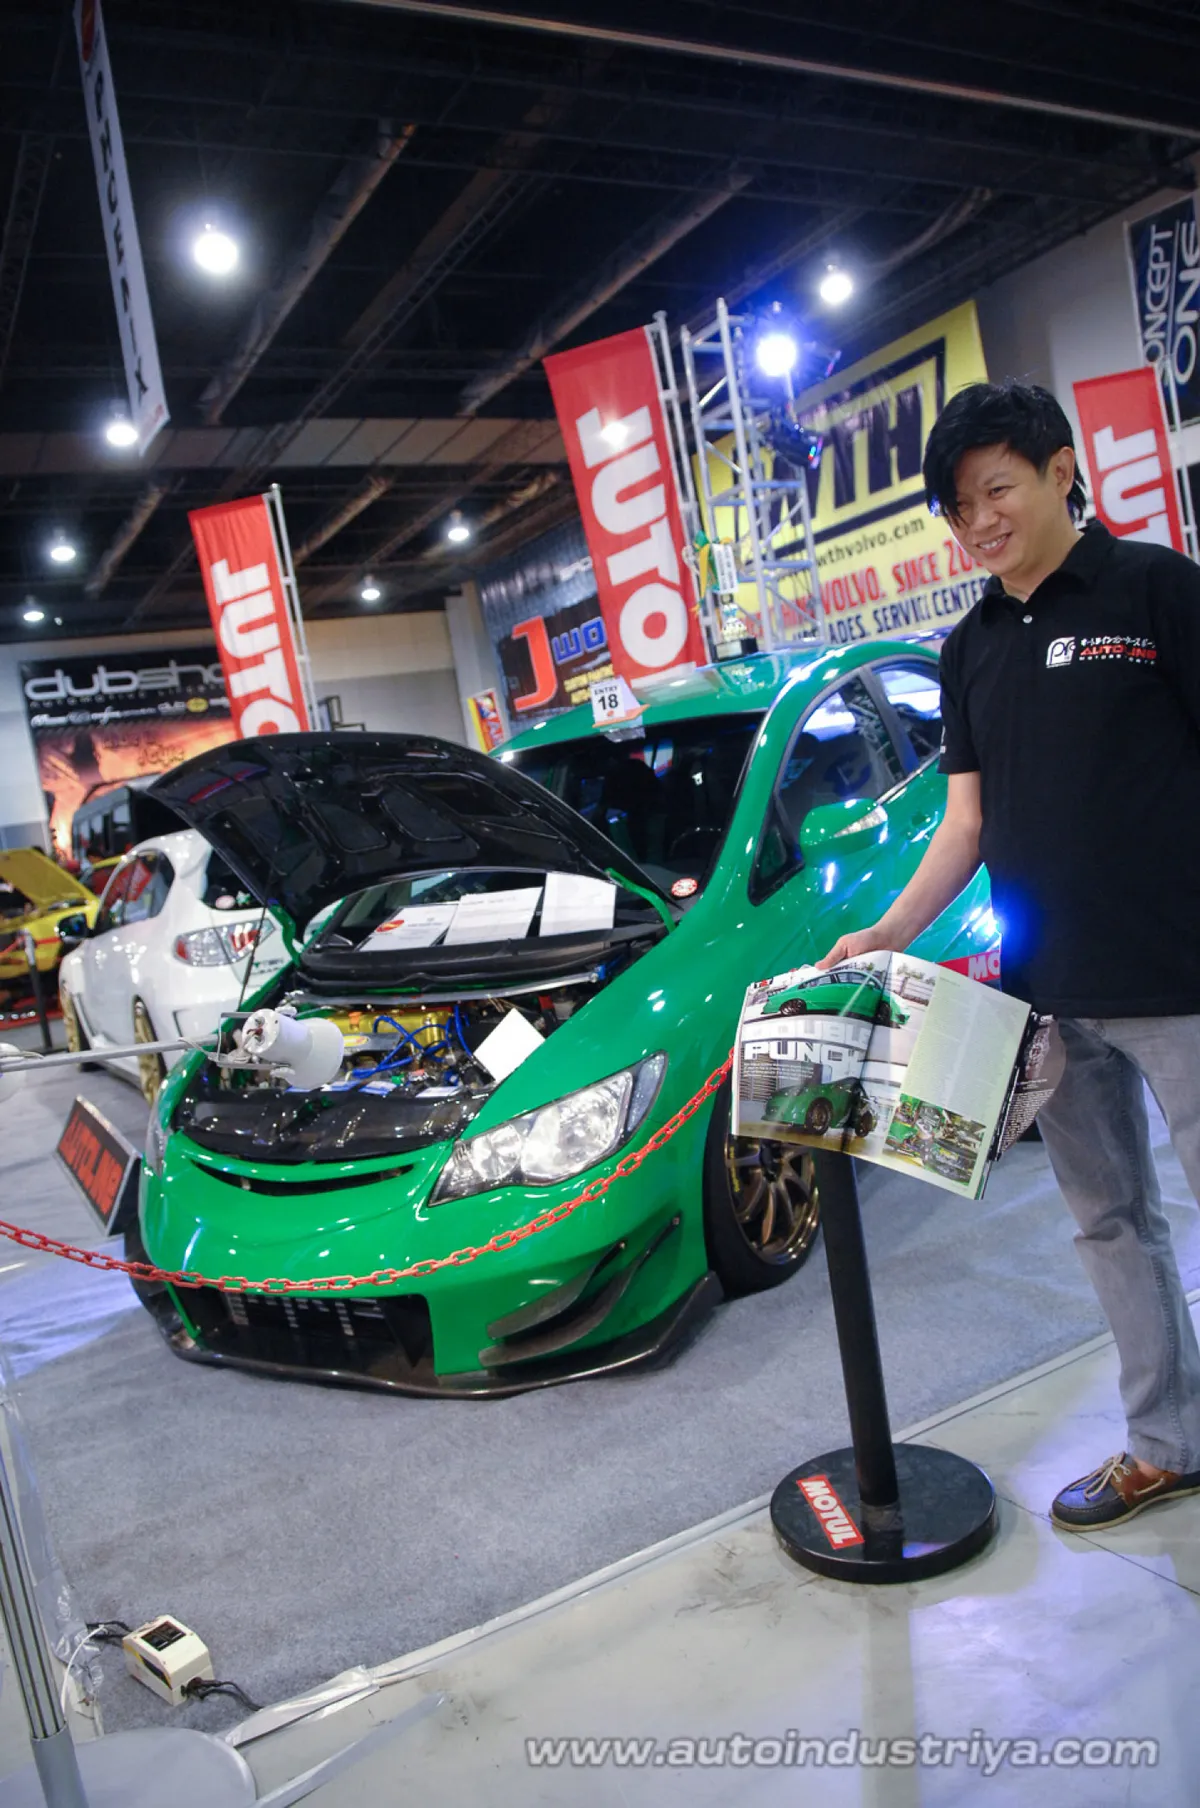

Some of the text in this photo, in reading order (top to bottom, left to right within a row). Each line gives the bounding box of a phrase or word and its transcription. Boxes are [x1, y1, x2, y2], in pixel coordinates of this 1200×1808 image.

[1143, 223, 1173, 382] ONCEPT
[1172, 221, 1200, 385] ONE
[594, 685, 618, 695] ENTRY
[598, 694, 619, 710] 18
[803, 1480, 861, 1548] MOTUL
